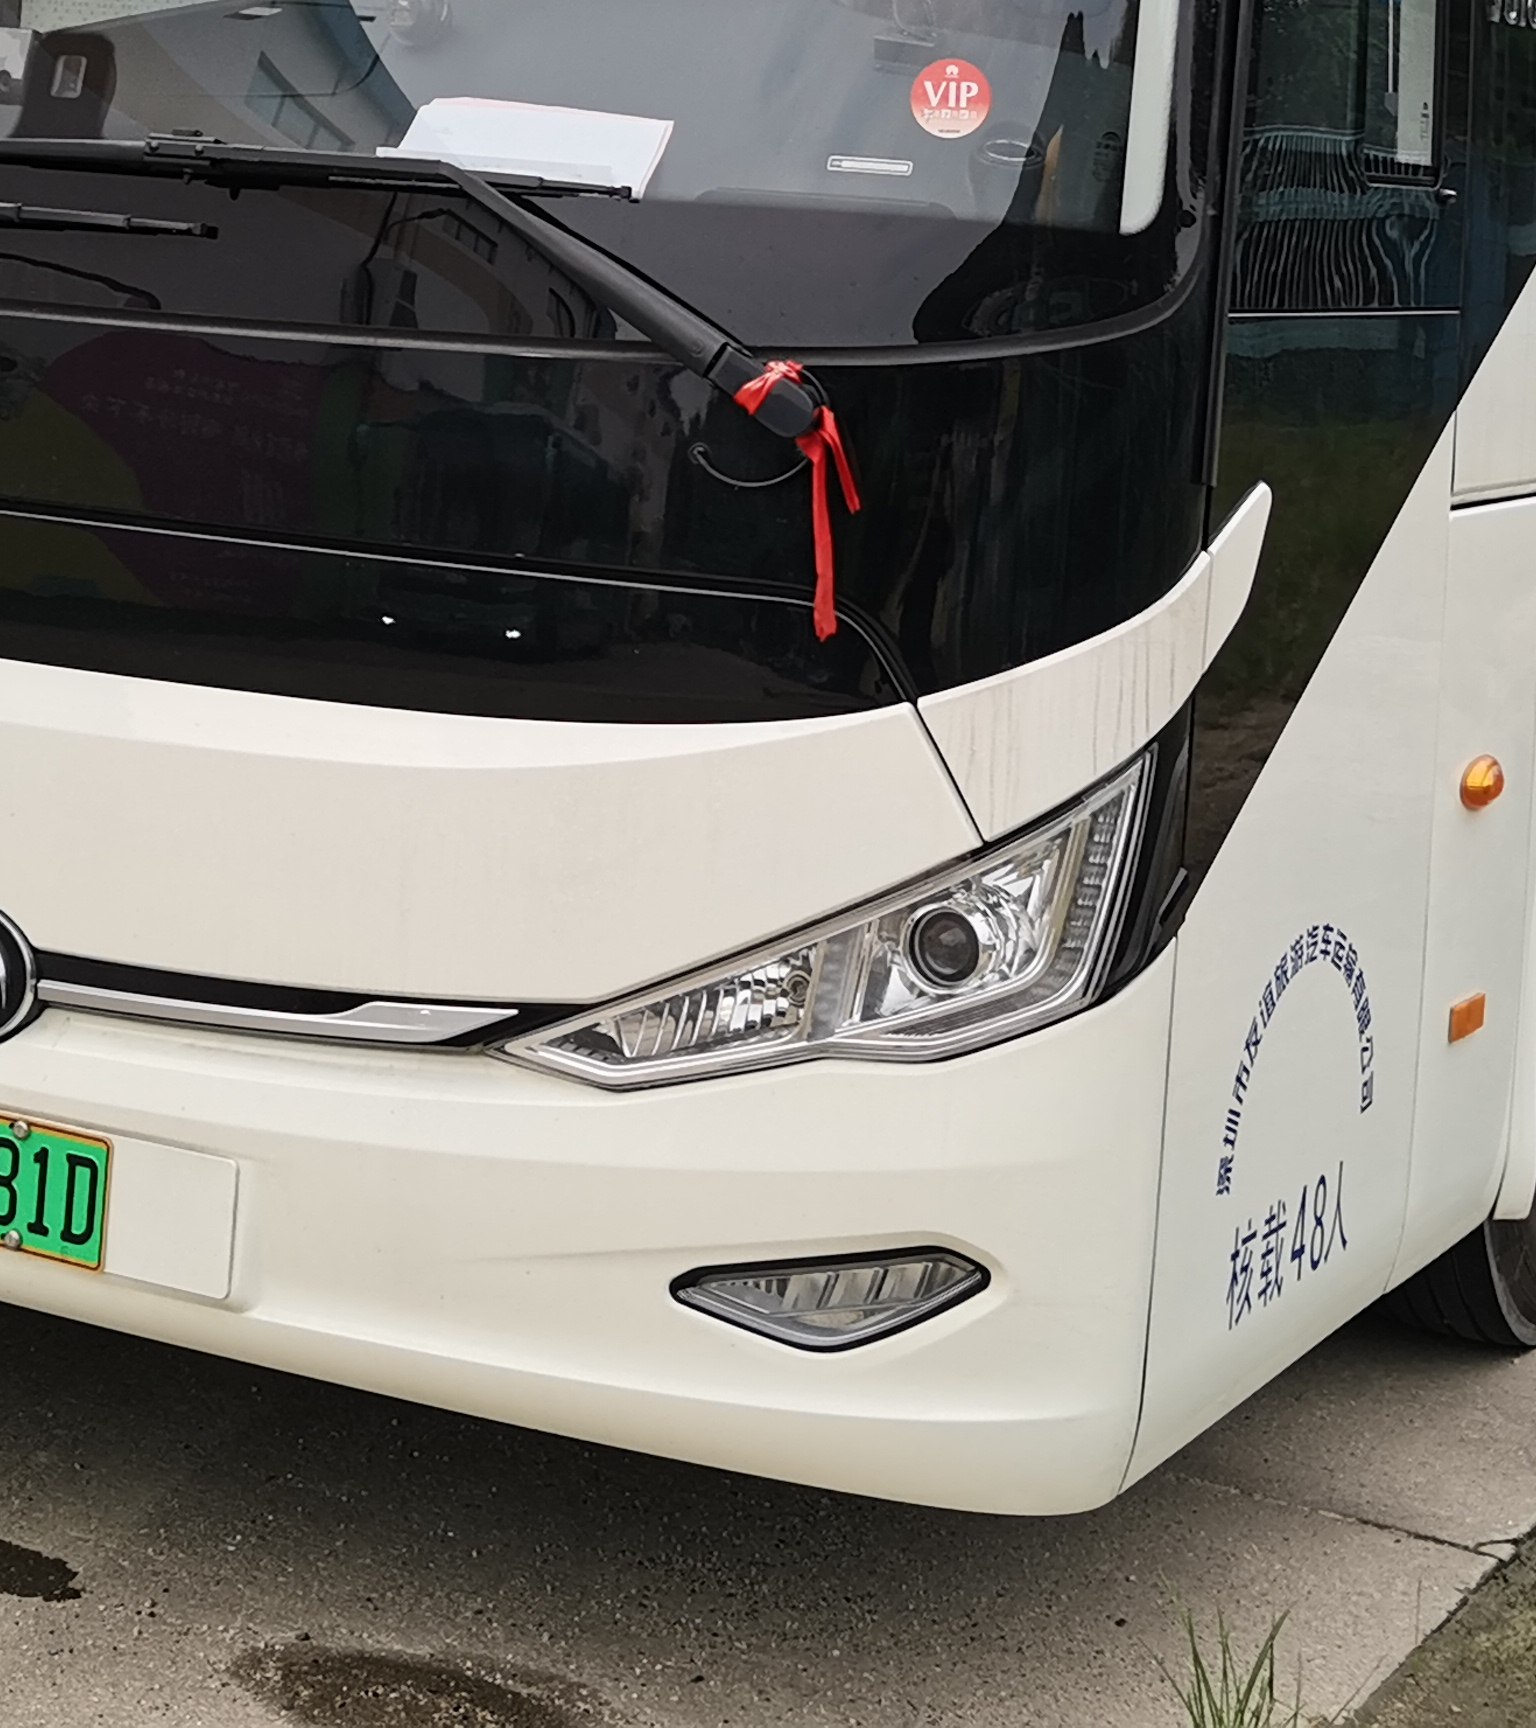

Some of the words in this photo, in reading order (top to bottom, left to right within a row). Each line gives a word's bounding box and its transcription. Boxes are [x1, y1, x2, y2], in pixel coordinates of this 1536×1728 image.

[923, 80, 979, 108] VIP
[1225, 1160, 1348, 1330] 核载48人
